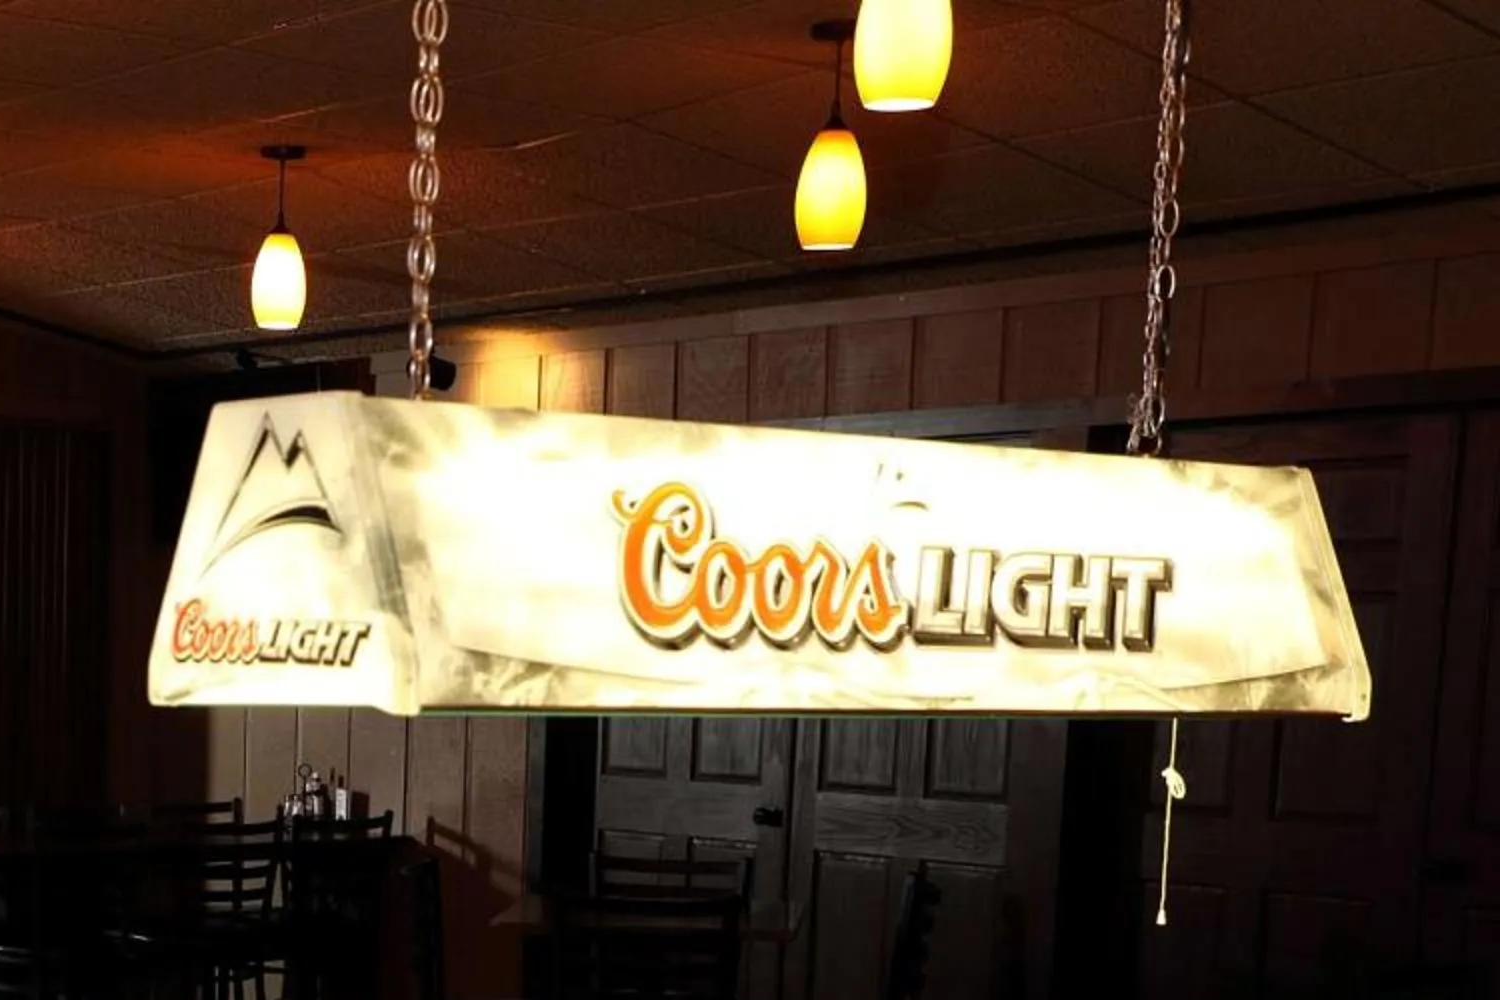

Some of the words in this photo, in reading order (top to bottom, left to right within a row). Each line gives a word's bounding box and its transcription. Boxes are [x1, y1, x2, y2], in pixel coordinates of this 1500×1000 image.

[611, 482, 910, 650] Coors
[911, 546, 1173, 652] LIGHT
[174, 598, 258, 664] Coors
[258, 619, 371, 667] LIGHT
